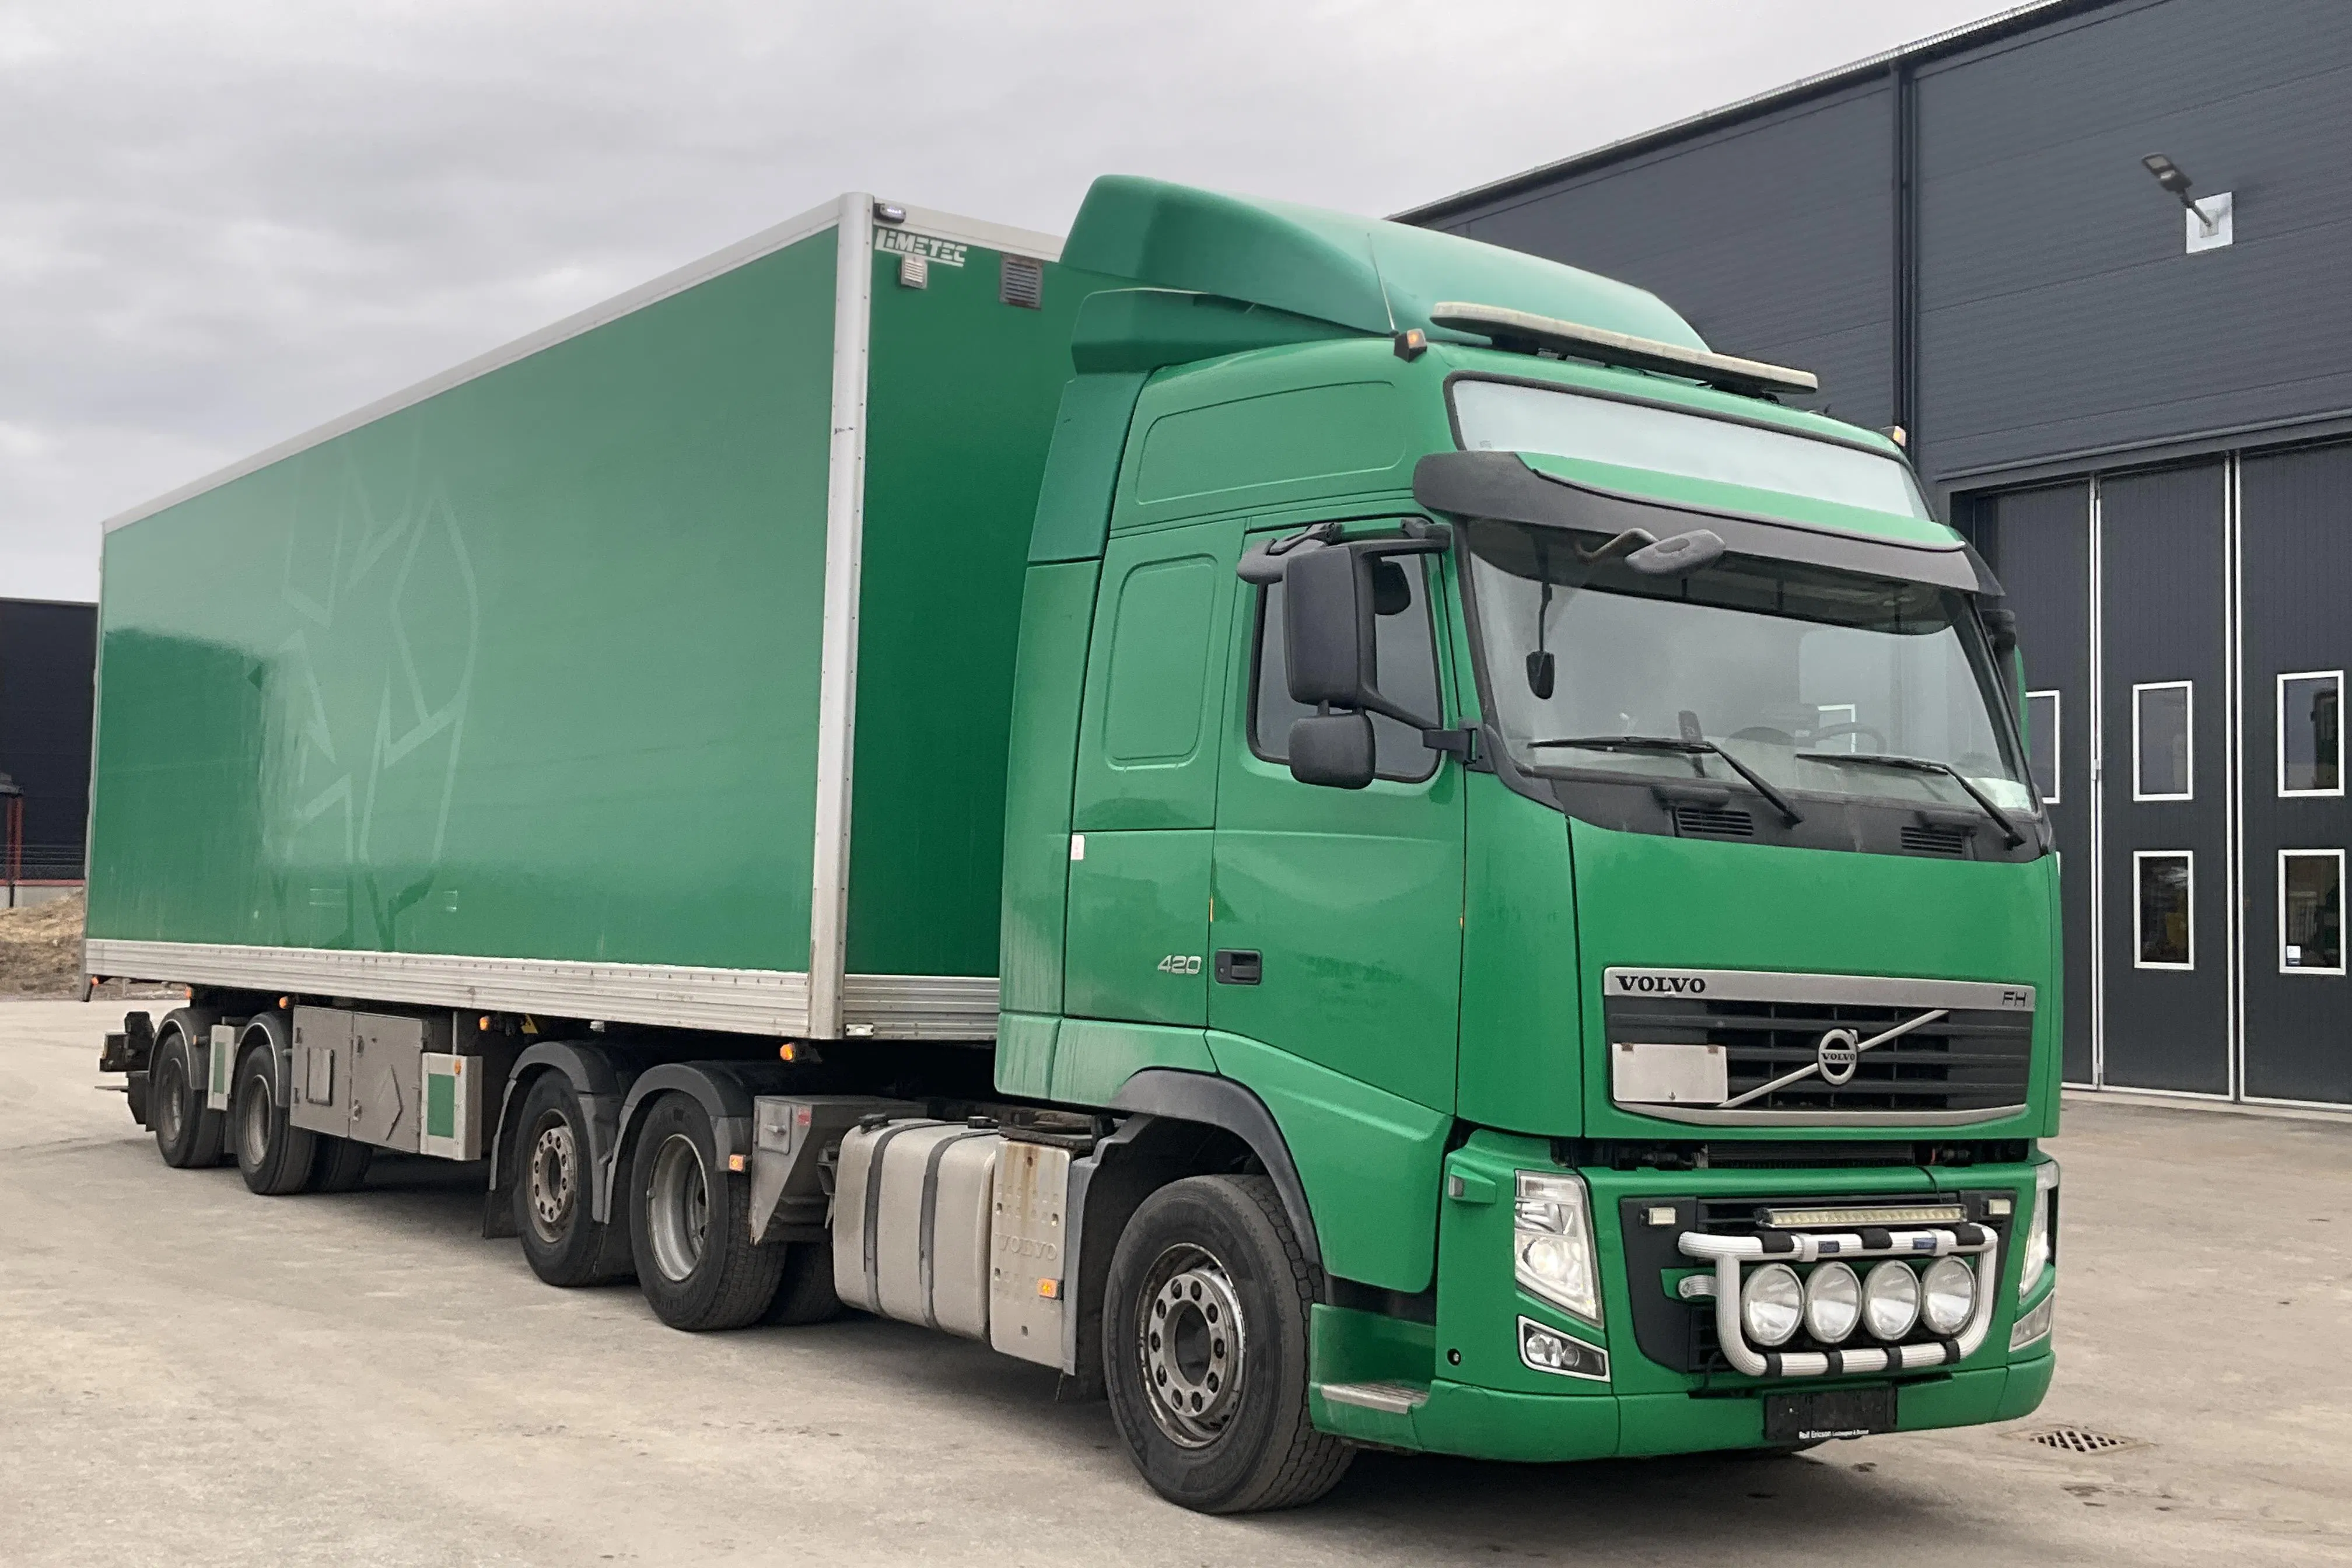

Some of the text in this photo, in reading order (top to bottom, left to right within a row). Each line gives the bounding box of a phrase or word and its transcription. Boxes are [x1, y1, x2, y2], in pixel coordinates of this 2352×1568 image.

[1157, 955, 1202, 974] 420
[1615, 975, 1706, 993] VOLVO
[2002, 991, 2027, 1007] FH
